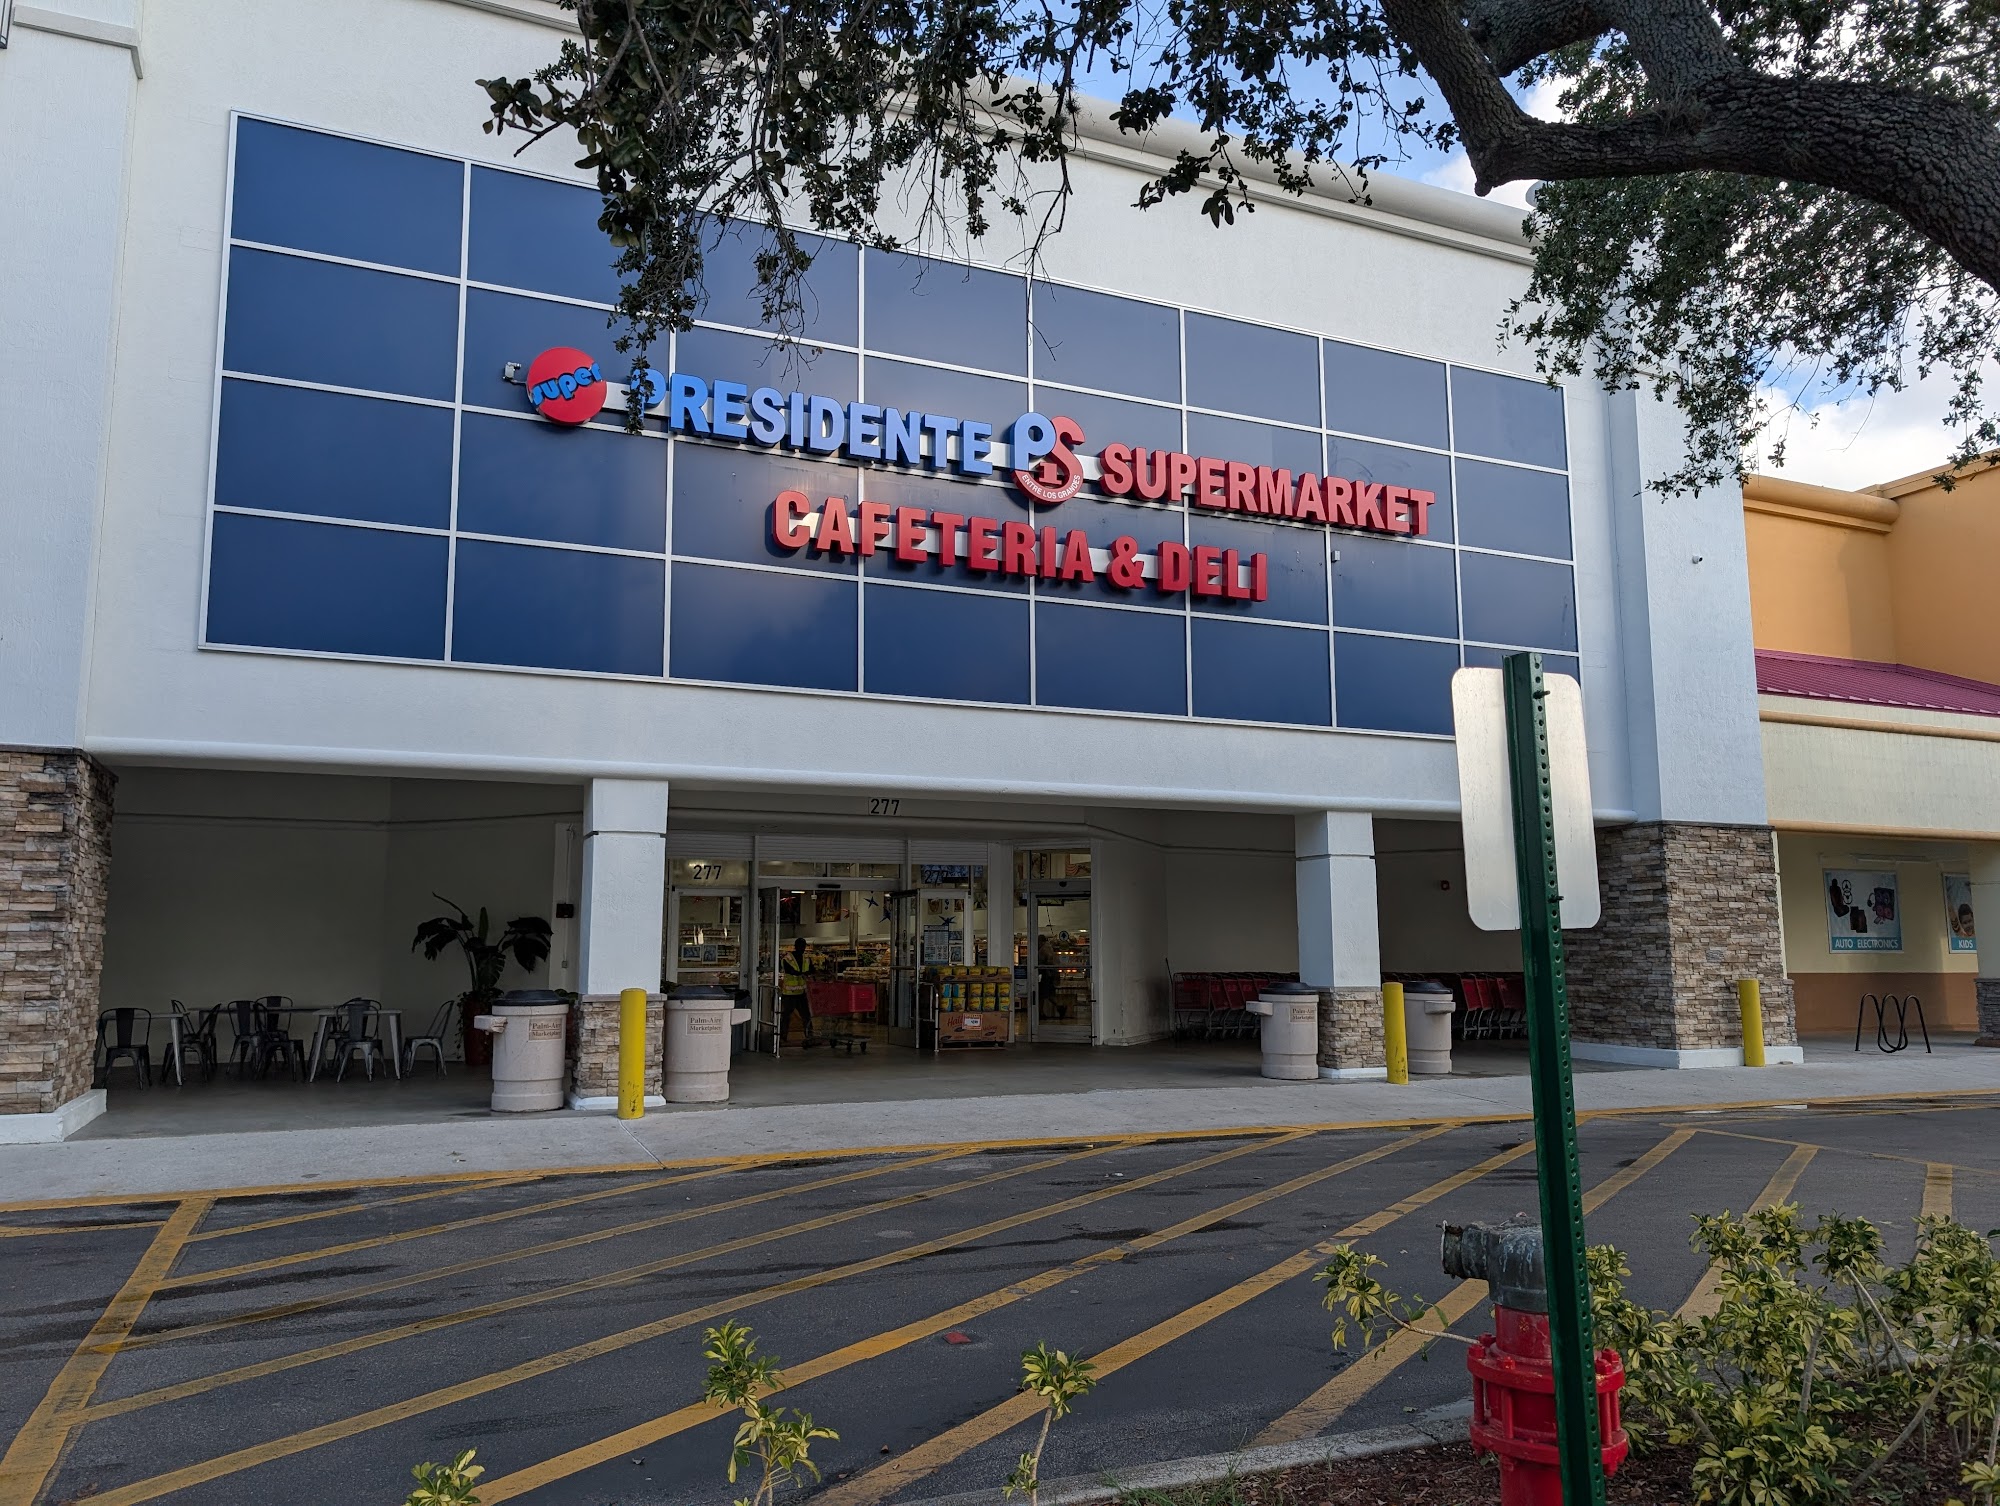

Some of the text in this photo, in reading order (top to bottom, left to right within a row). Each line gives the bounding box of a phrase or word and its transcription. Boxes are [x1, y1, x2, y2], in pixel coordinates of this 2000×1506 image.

[531, 362, 603, 406] super
[630, 368, 993, 476] PRESIDENTE
[1099, 443, 1435, 536] SUPERMARKET
[1021, 474, 1081, 499] ENTRE LOS GRANDES
[772, 490, 1268, 602] CAFETERIA & DELI
[870, 798, 900, 815] 277
[693, 864, 722, 880] 277
[924, 869, 949, 887] 277
[1835, 939, 1898, 949] AUTO ELECTRONICS
[1958, 939, 1974, 949] KIDS
